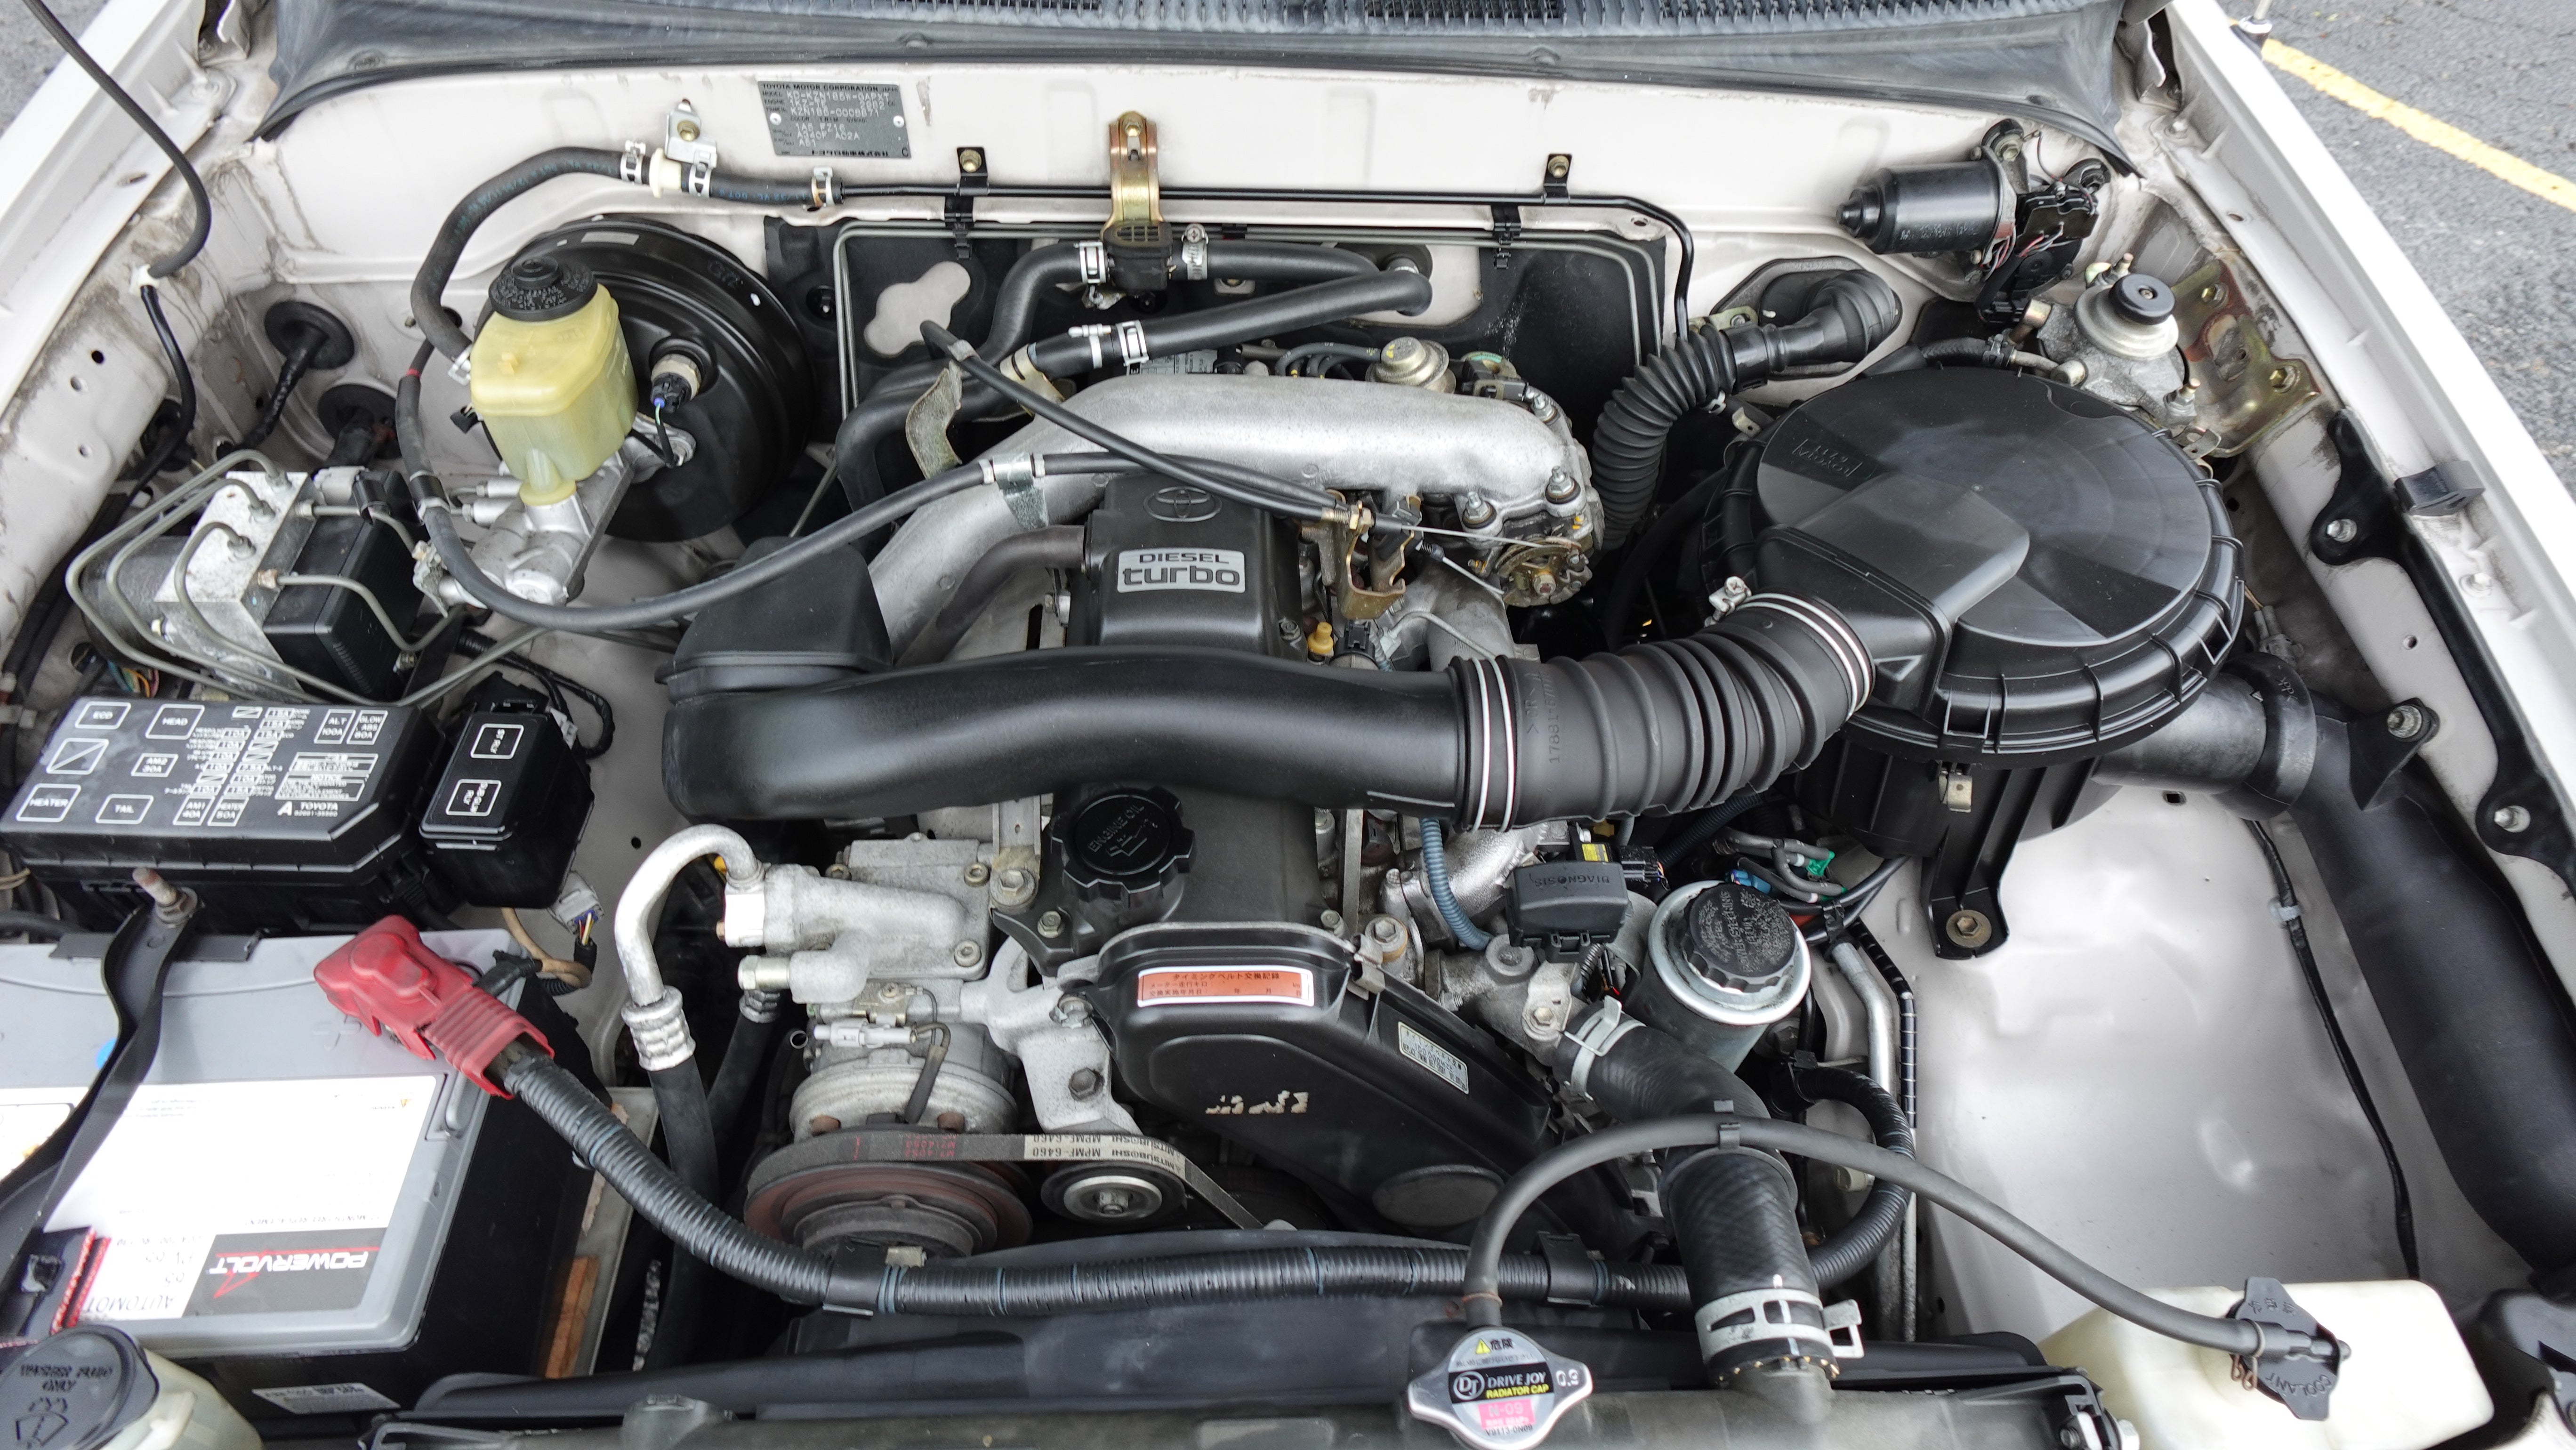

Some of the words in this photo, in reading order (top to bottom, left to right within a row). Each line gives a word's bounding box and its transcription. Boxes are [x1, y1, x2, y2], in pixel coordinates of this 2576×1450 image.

[1139, 553, 1230, 564] DIESEL
[1122, 565, 1240, 586] turbo
[162, 717, 188, 726] HEAD
[328, 717, 347, 725] ALT
[29, 798, 69, 807] HEATER
[114, 804, 135, 814] TAIL
[277, 801, 293, 816] A
[300, 802, 338, 811] TOYOTA
[1088, 816, 1128, 853] ENGINE
[1126, 805, 1145, 820] OIL
[1534, 874, 1610, 887] DIAGNOSIS
[1112, 1149, 1175, 1169] MITSUBOSHI
[206, 1251, 369, 1275] POWERVOLT
[1487, 1374, 1523, 1388] DRIVE
[1525, 1372, 1547, 1387] JOY
[1556, 1368, 1579, 1387] 0.9
[2266, 1372, 2332, 1397] COOLANT
[1485, 1385, 1530, 1399] RADIATOR
[1530, 1383, 1550, 1394] CAP
[1489, 1402, 1524, 1418] N-09
